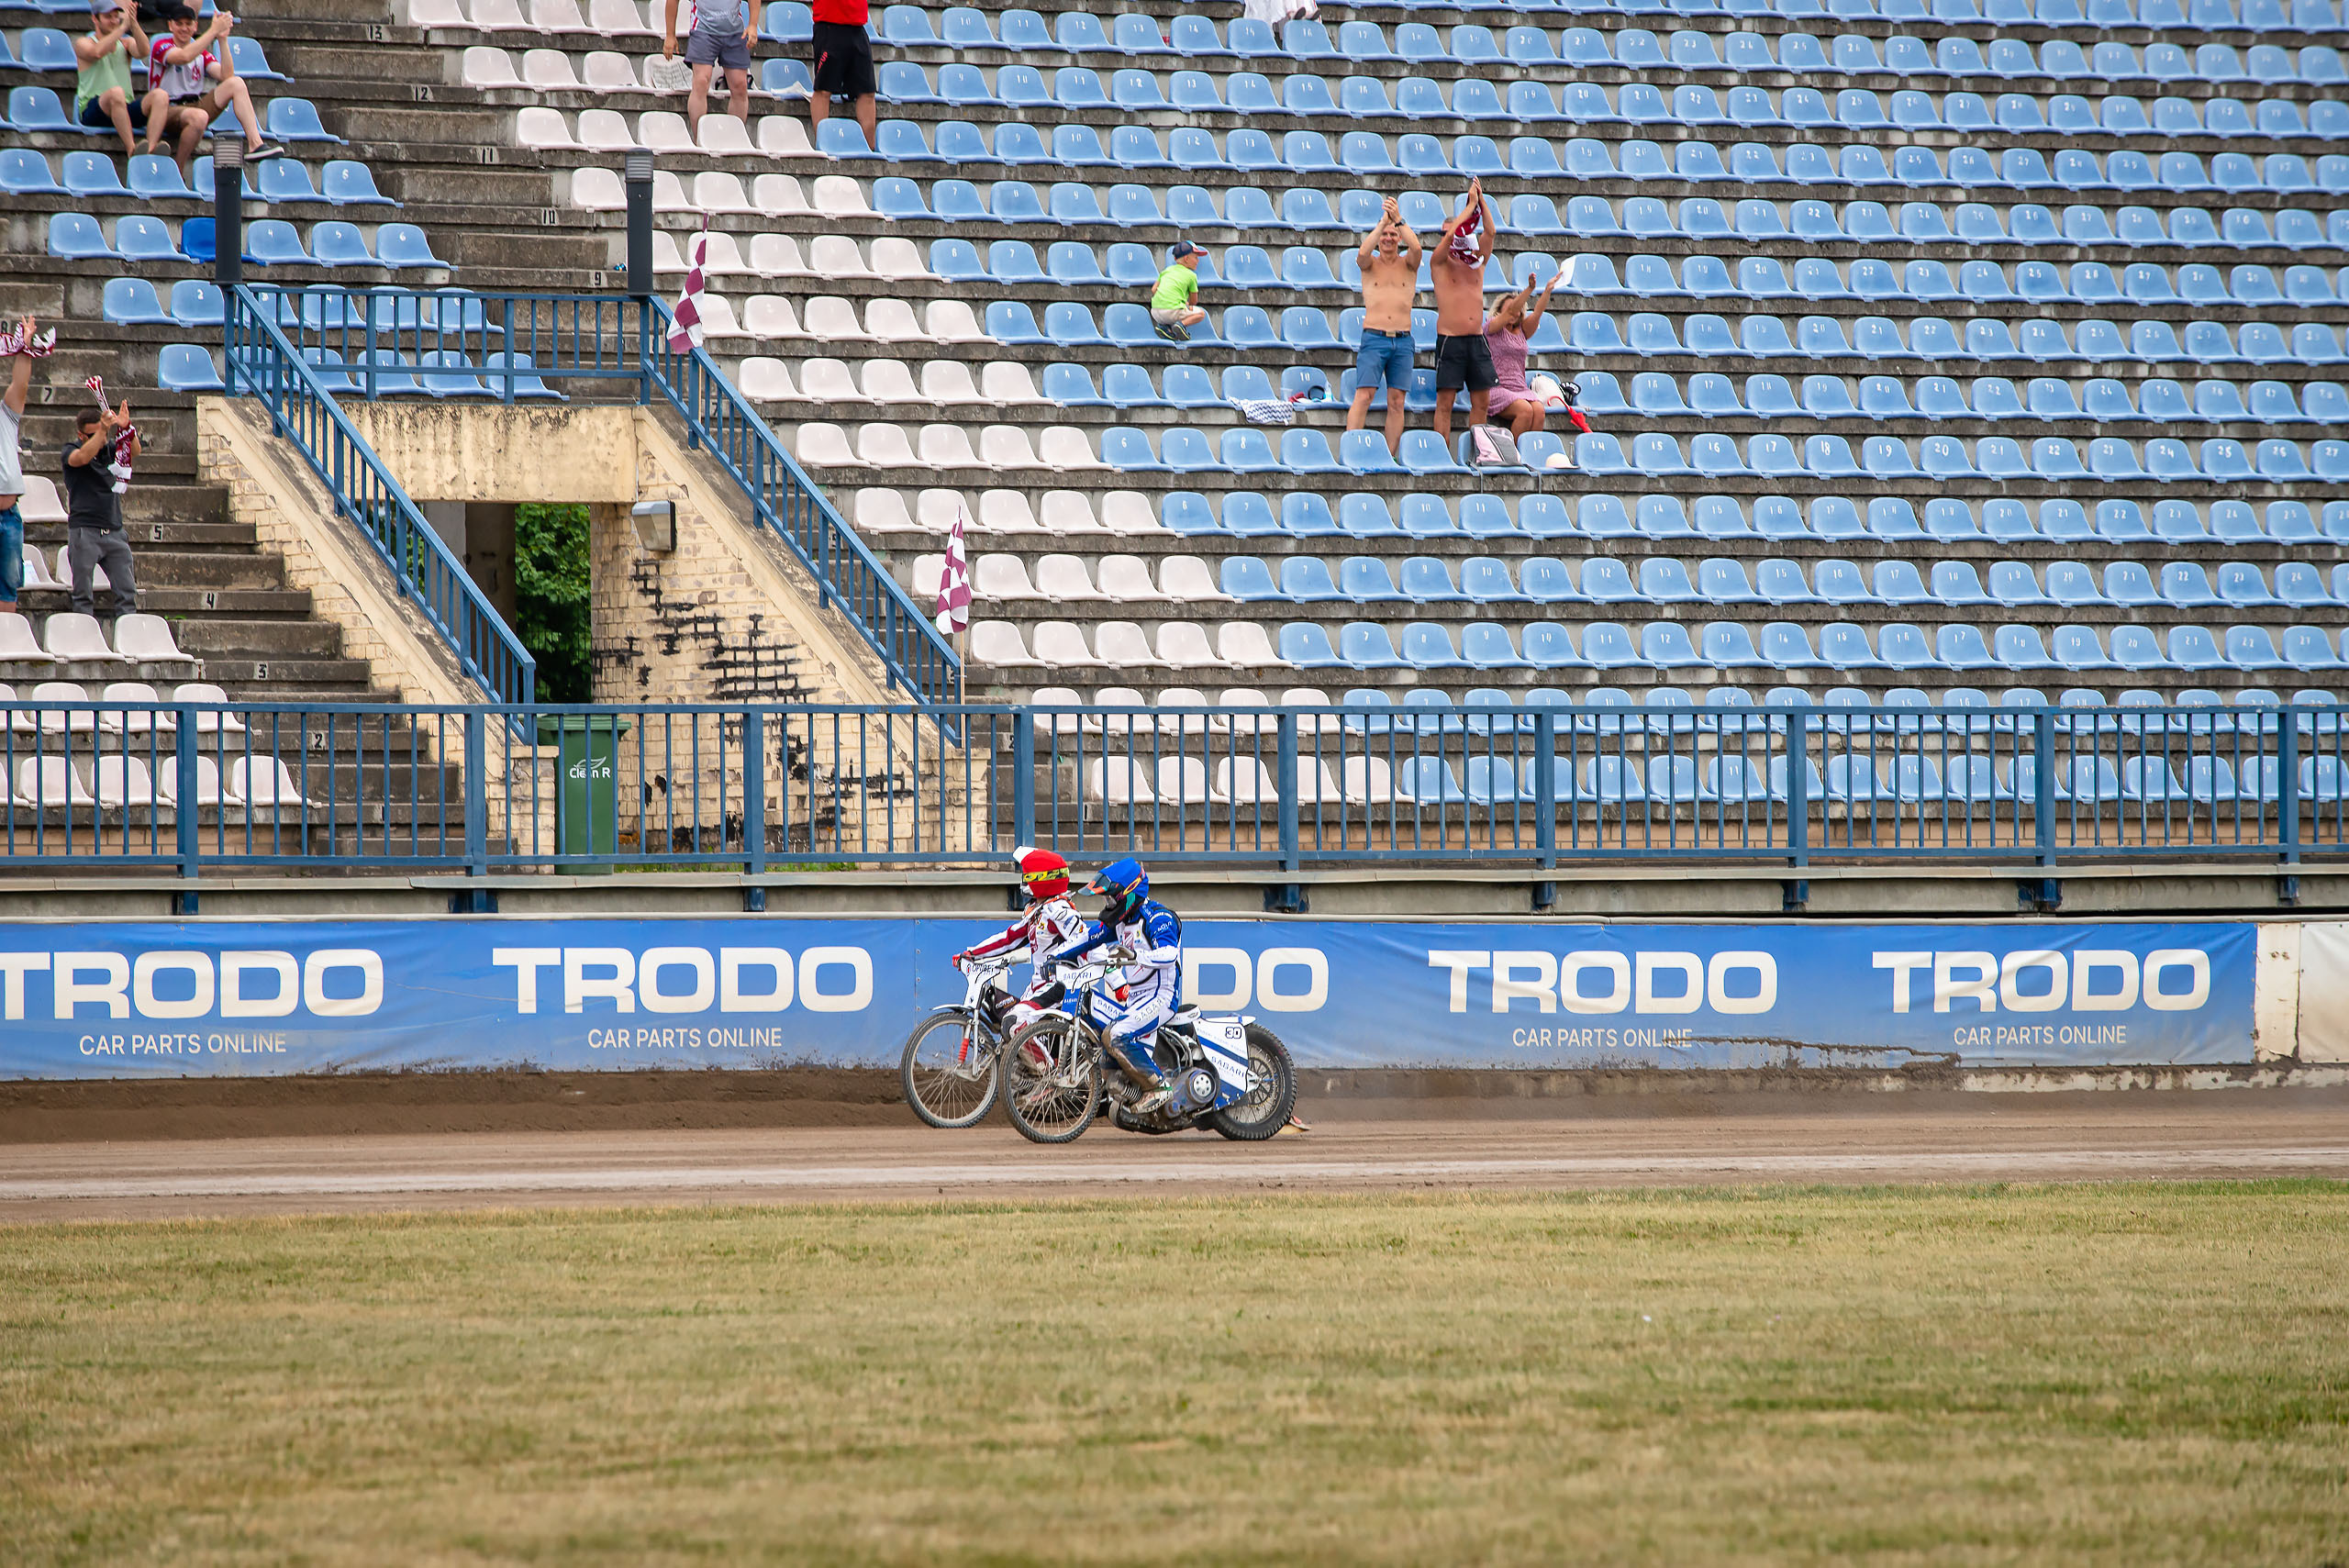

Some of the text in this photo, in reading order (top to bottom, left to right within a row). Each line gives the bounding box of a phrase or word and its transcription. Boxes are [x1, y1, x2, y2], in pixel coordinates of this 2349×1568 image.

[1018, 18, 1029, 28] 11
[1074, 20, 1086, 30] 12
[368, 25, 383, 41] 13
[1358, 29, 1368, 39] 17
[1574, 36, 1586, 46] 21
[1074, 74, 1085, 85] 11
[1130, 77, 1143, 88] 12
[1186, 78, 1197, 89] 13
[415, 84, 429, 101] 12
[1301, 81, 1313, 93] 15
[1413, 84, 1424, 95] 17
[1633, 90, 1650, 101] 21
[1689, 91, 1701, 106] 22
[1130, 133, 1139, 145] 11
[1186, 135, 1201, 146] 12
[1414, 141, 1425, 153] 16
[1469, 144, 1481, 155] 17
[1581, 146, 1592, 157] 19
[482, 147, 493, 162] 11
[1186, 193, 1195, 204] 11
[1527, 202, 1538, 212] 17
[1808, 206, 1821, 218] 22
[543, 209, 556, 225] 10
[1240, 253, 1251, 264] 11
[1297, 253, 1308, 265] 12
[1529, 260, 1541, 271] 16
[1585, 261, 1598, 272] 17
[1862, 263, 1875, 276] 22
[595, 272, 601, 286] 9
[1298, 315, 1309, 327] 11
[1586, 319, 1600, 330] 16
[1642, 322, 1653, 333] 17
[1871, 323, 1883, 335] 21
[1923, 324, 1937, 335] 22
[1979, 325, 1994, 338] 23
[1704, 379, 1714, 390] 17
[1932, 382, 1946, 394] 21
[1987, 384, 2001, 396] 22
[44, 387, 52, 402] 7
[1120, 437, 1128, 449] 6
[1183, 437, 1189, 448] 7
[1240, 435, 1247, 450] 8
[1301, 436, 1308, 449] 9
[1357, 434, 1372, 448] 10
[1418, 438, 1428, 449] 11
[1591, 439, 1606, 451] 14
[1651, 439, 1664, 451] 15
[1709, 440, 1720, 454] 16
[1765, 439, 1777, 452] 17
[1820, 439, 1831, 456] 18
[1878, 443, 1892, 458] 19
[1934, 441, 1950, 457] 20
[1990, 444, 2004, 456] 21
[2048, 444, 2061, 456] 22
[2159, 444, 2175, 459] 24
[2217, 445, 2232, 459] 25
[2324, 446, 2339, 457] 27
[1475, 502, 1486, 514] 11
[1536, 502, 1547, 515] 12
[1653, 503, 1664, 515] 14
[1826, 504, 1835, 515] 17
[2057, 506, 2068, 518] 21
[2113, 507, 2127, 520] 22
[154, 524, 162, 540] 5
[1482, 565, 1492, 577] 10
[1541, 567, 1551, 579] 11
[1600, 567, 1611, 578] 12
[1776, 567, 1787, 579] 15
[1832, 568, 1843, 580] 16
[2177, 570, 2188, 582] 22
[2063, 572, 2074, 583] 20
[206, 593, 215, 609] 4
[1600, 633, 1612, 644] 11
[1660, 632, 1671, 644] 12
[1954, 630, 1966, 644] 17
[2071, 637, 2081, 647] 19
[258, 663, 267, 679] 3
[1664, 696, 1676, 706] 11
[1724, 694, 1737, 707] 12
[1959, 696, 1971, 707] 16
[315, 733, 322, 749] 2
[569, 767, 611, 778] Clen R
[0, 948, 384, 1020] TRODO
[492, 946, 874, 1014] TRODO
[1428, 947, 1777, 1014] TRODO
[1872, 948, 2211, 1014] TRODO
[587, 1027, 782, 1049] CAR PARTS ONLINE
[1225, 1027, 1242, 1040] 30
[1512, 1028, 1693, 1048] CAR PARTS ONLINE
[1954, 1024, 2127, 1046] CAR PARTS ONLINE
[79, 1033, 287, 1056] CAR PARTS ONLINE
